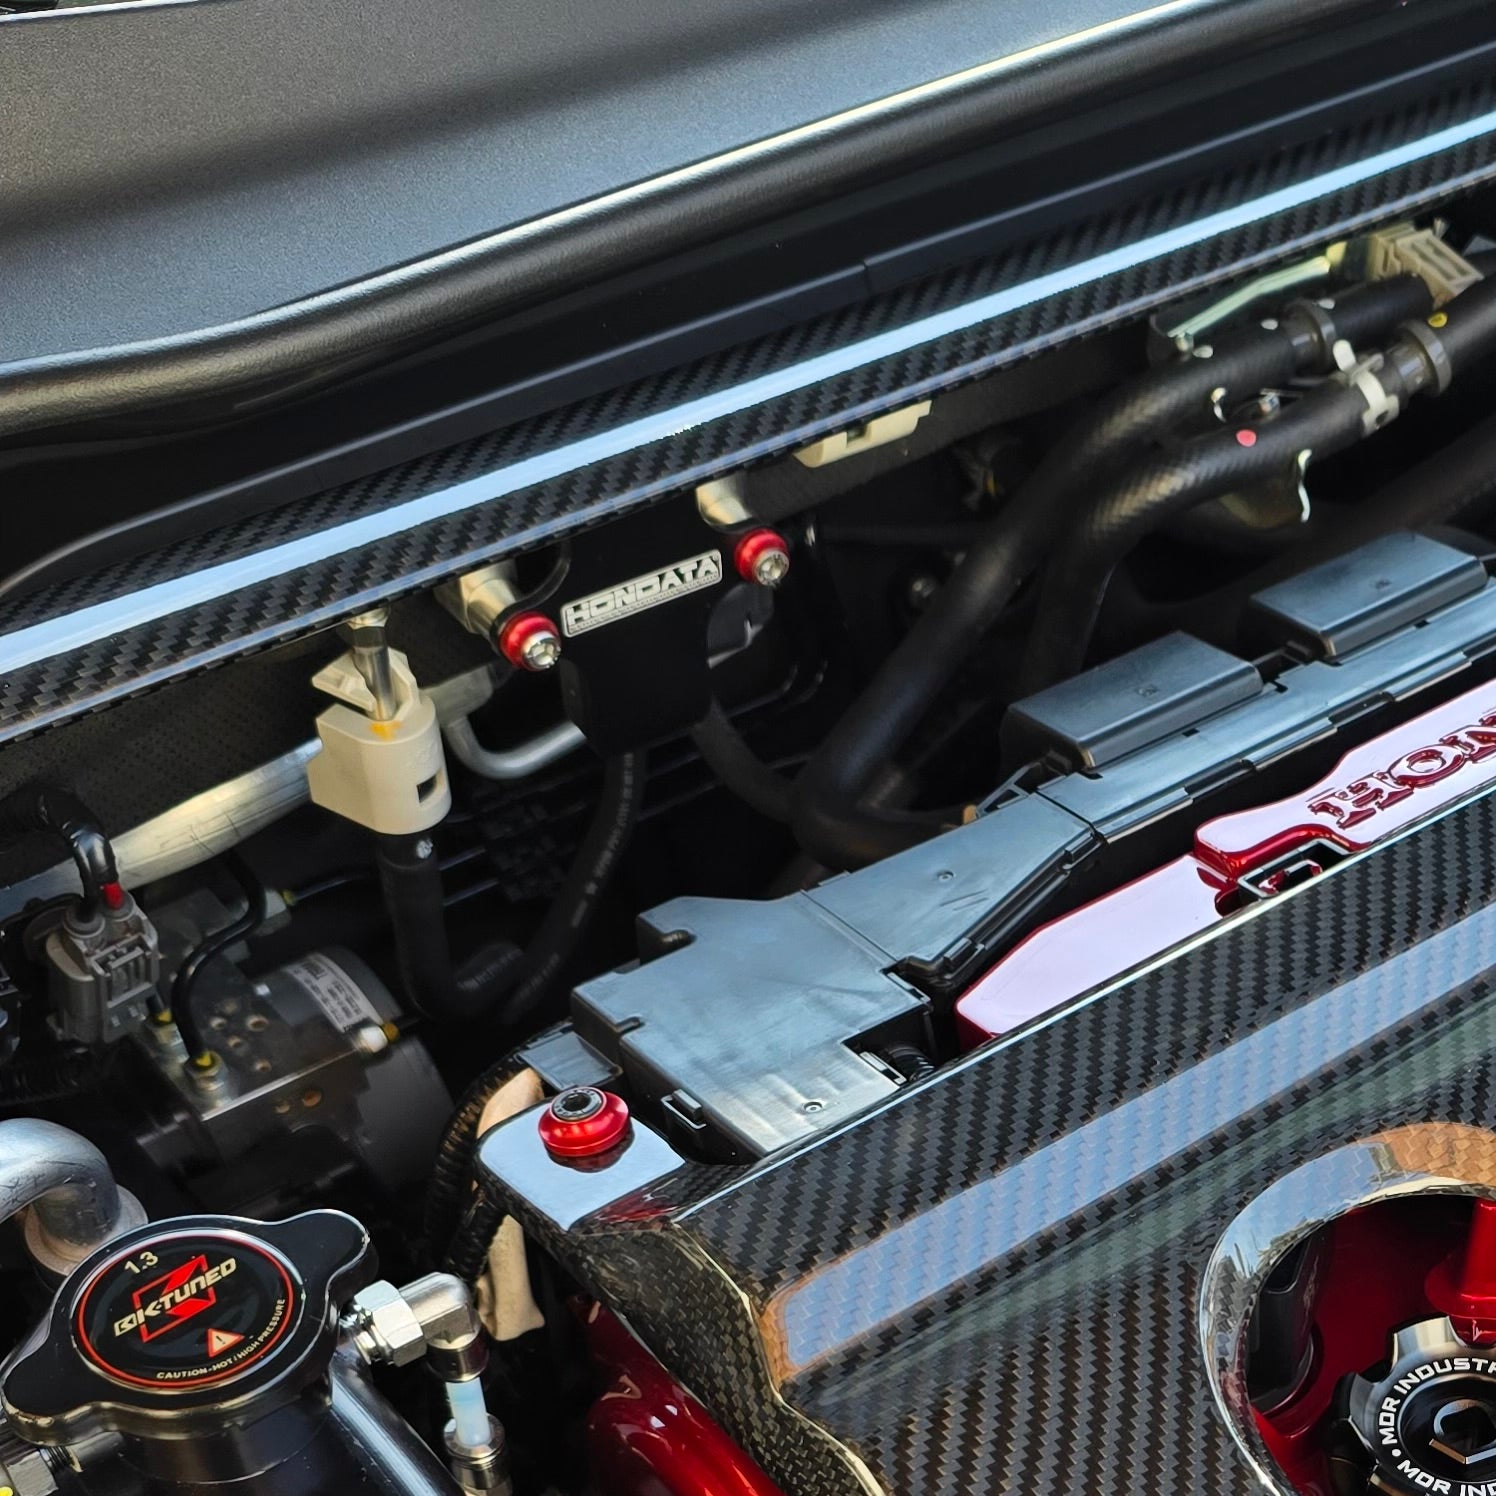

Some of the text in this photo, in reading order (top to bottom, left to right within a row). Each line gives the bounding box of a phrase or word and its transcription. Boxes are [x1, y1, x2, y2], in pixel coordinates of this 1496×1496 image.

[566, 555, 721, 627] HONDATA
[124, 1251, 159, 1275] 1.3
[237, 1341, 260, 1359] HIGH
[257, 1298, 286, 1342] PRESSURE
